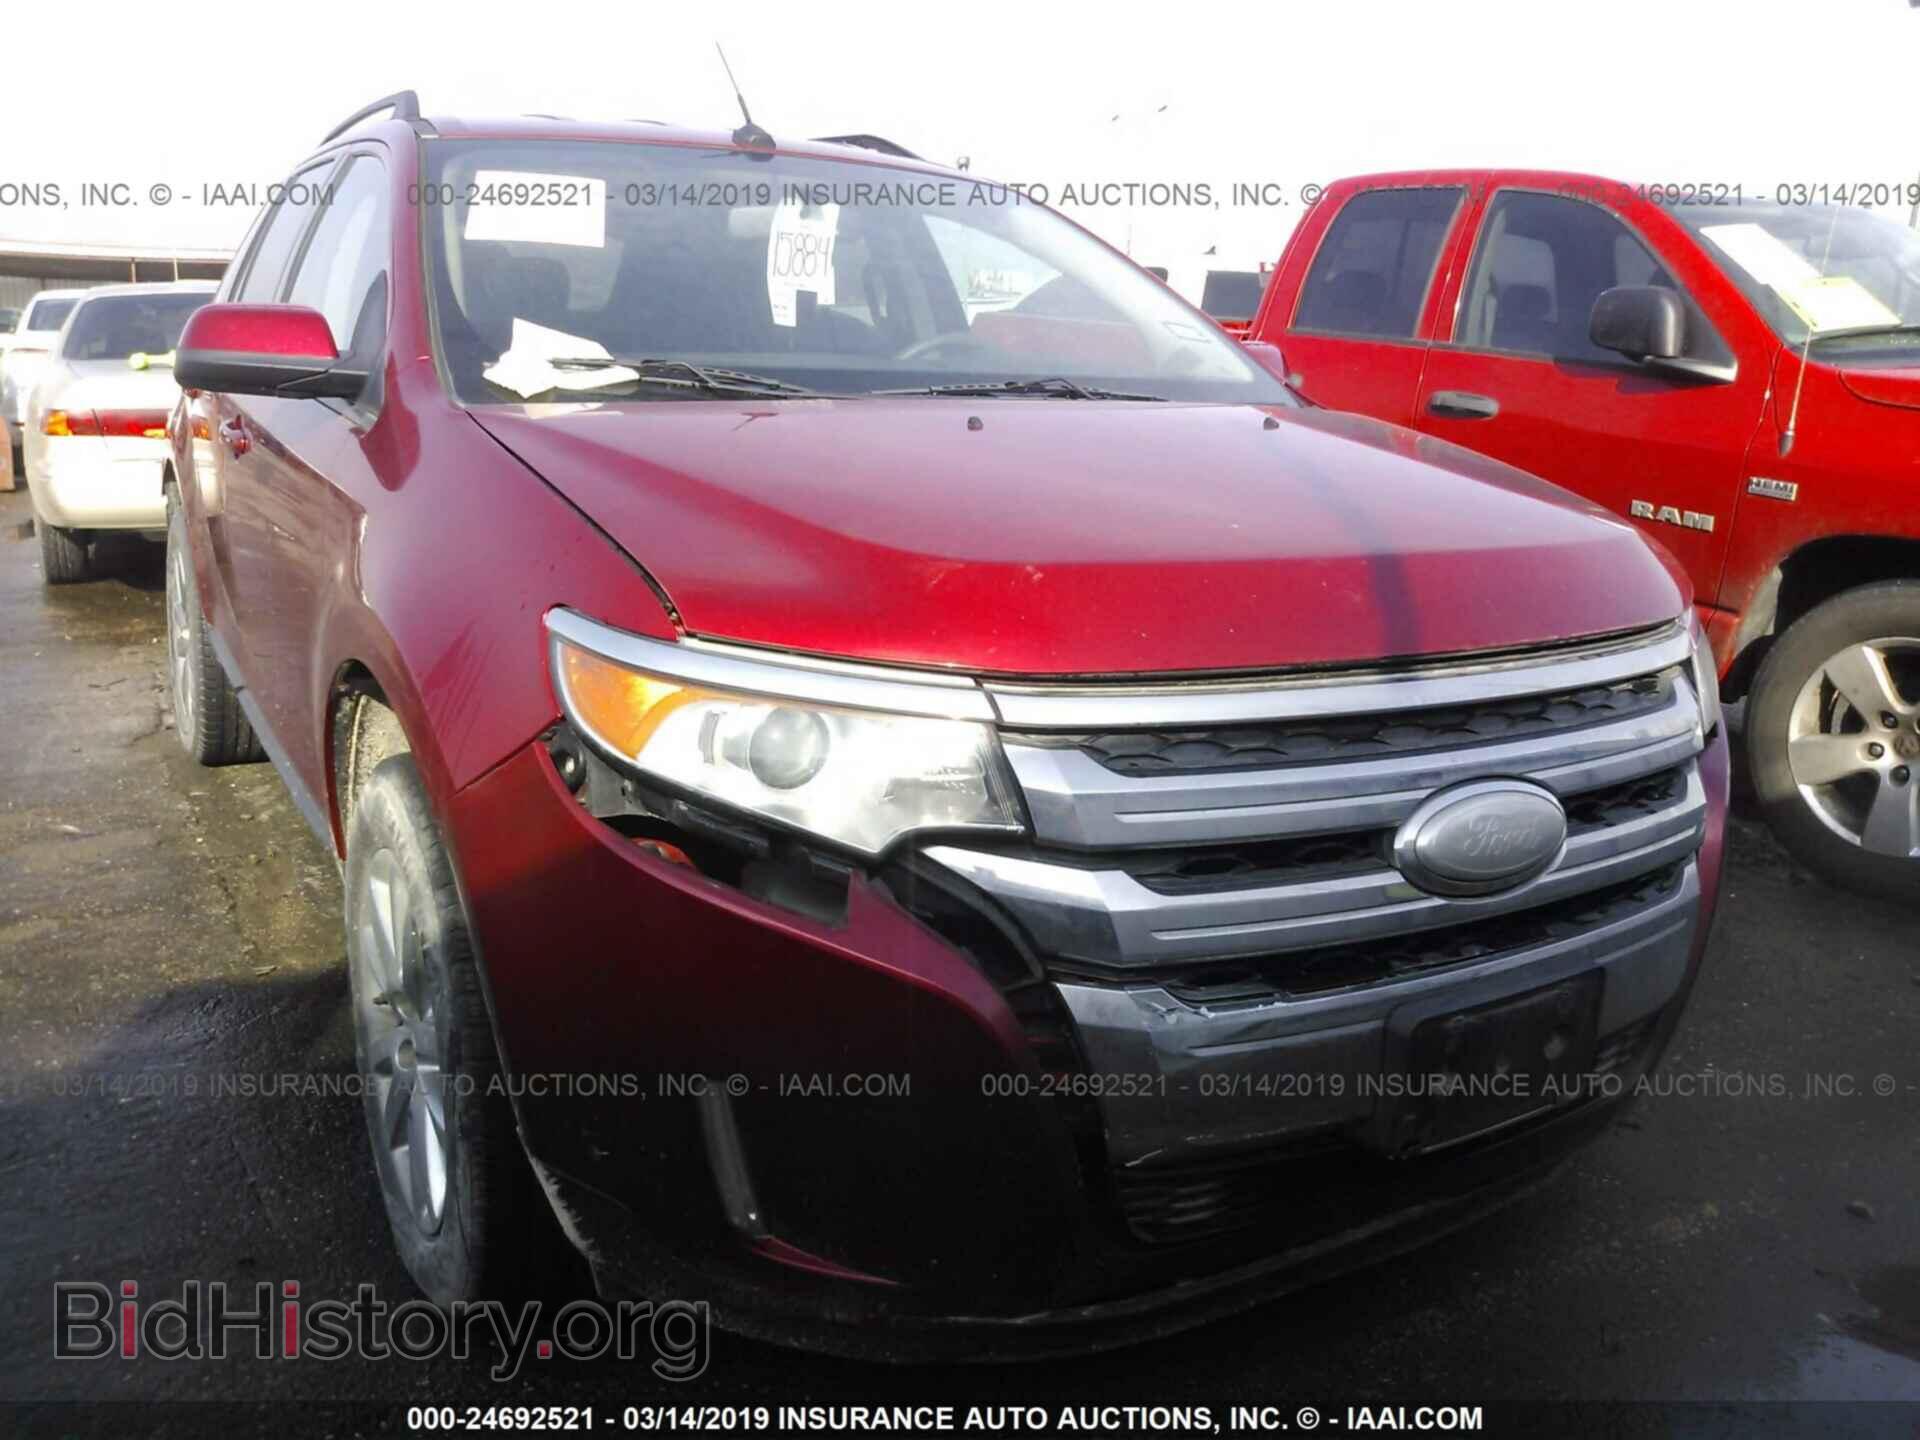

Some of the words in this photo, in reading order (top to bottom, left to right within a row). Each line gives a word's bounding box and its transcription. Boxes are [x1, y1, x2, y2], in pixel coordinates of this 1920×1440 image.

[773, 231, 831, 278] 15884
[1750, 477, 1796, 495] HEMI
[1630, 498, 1715, 533] RAM
[1463, 814, 1538, 857] Ford
